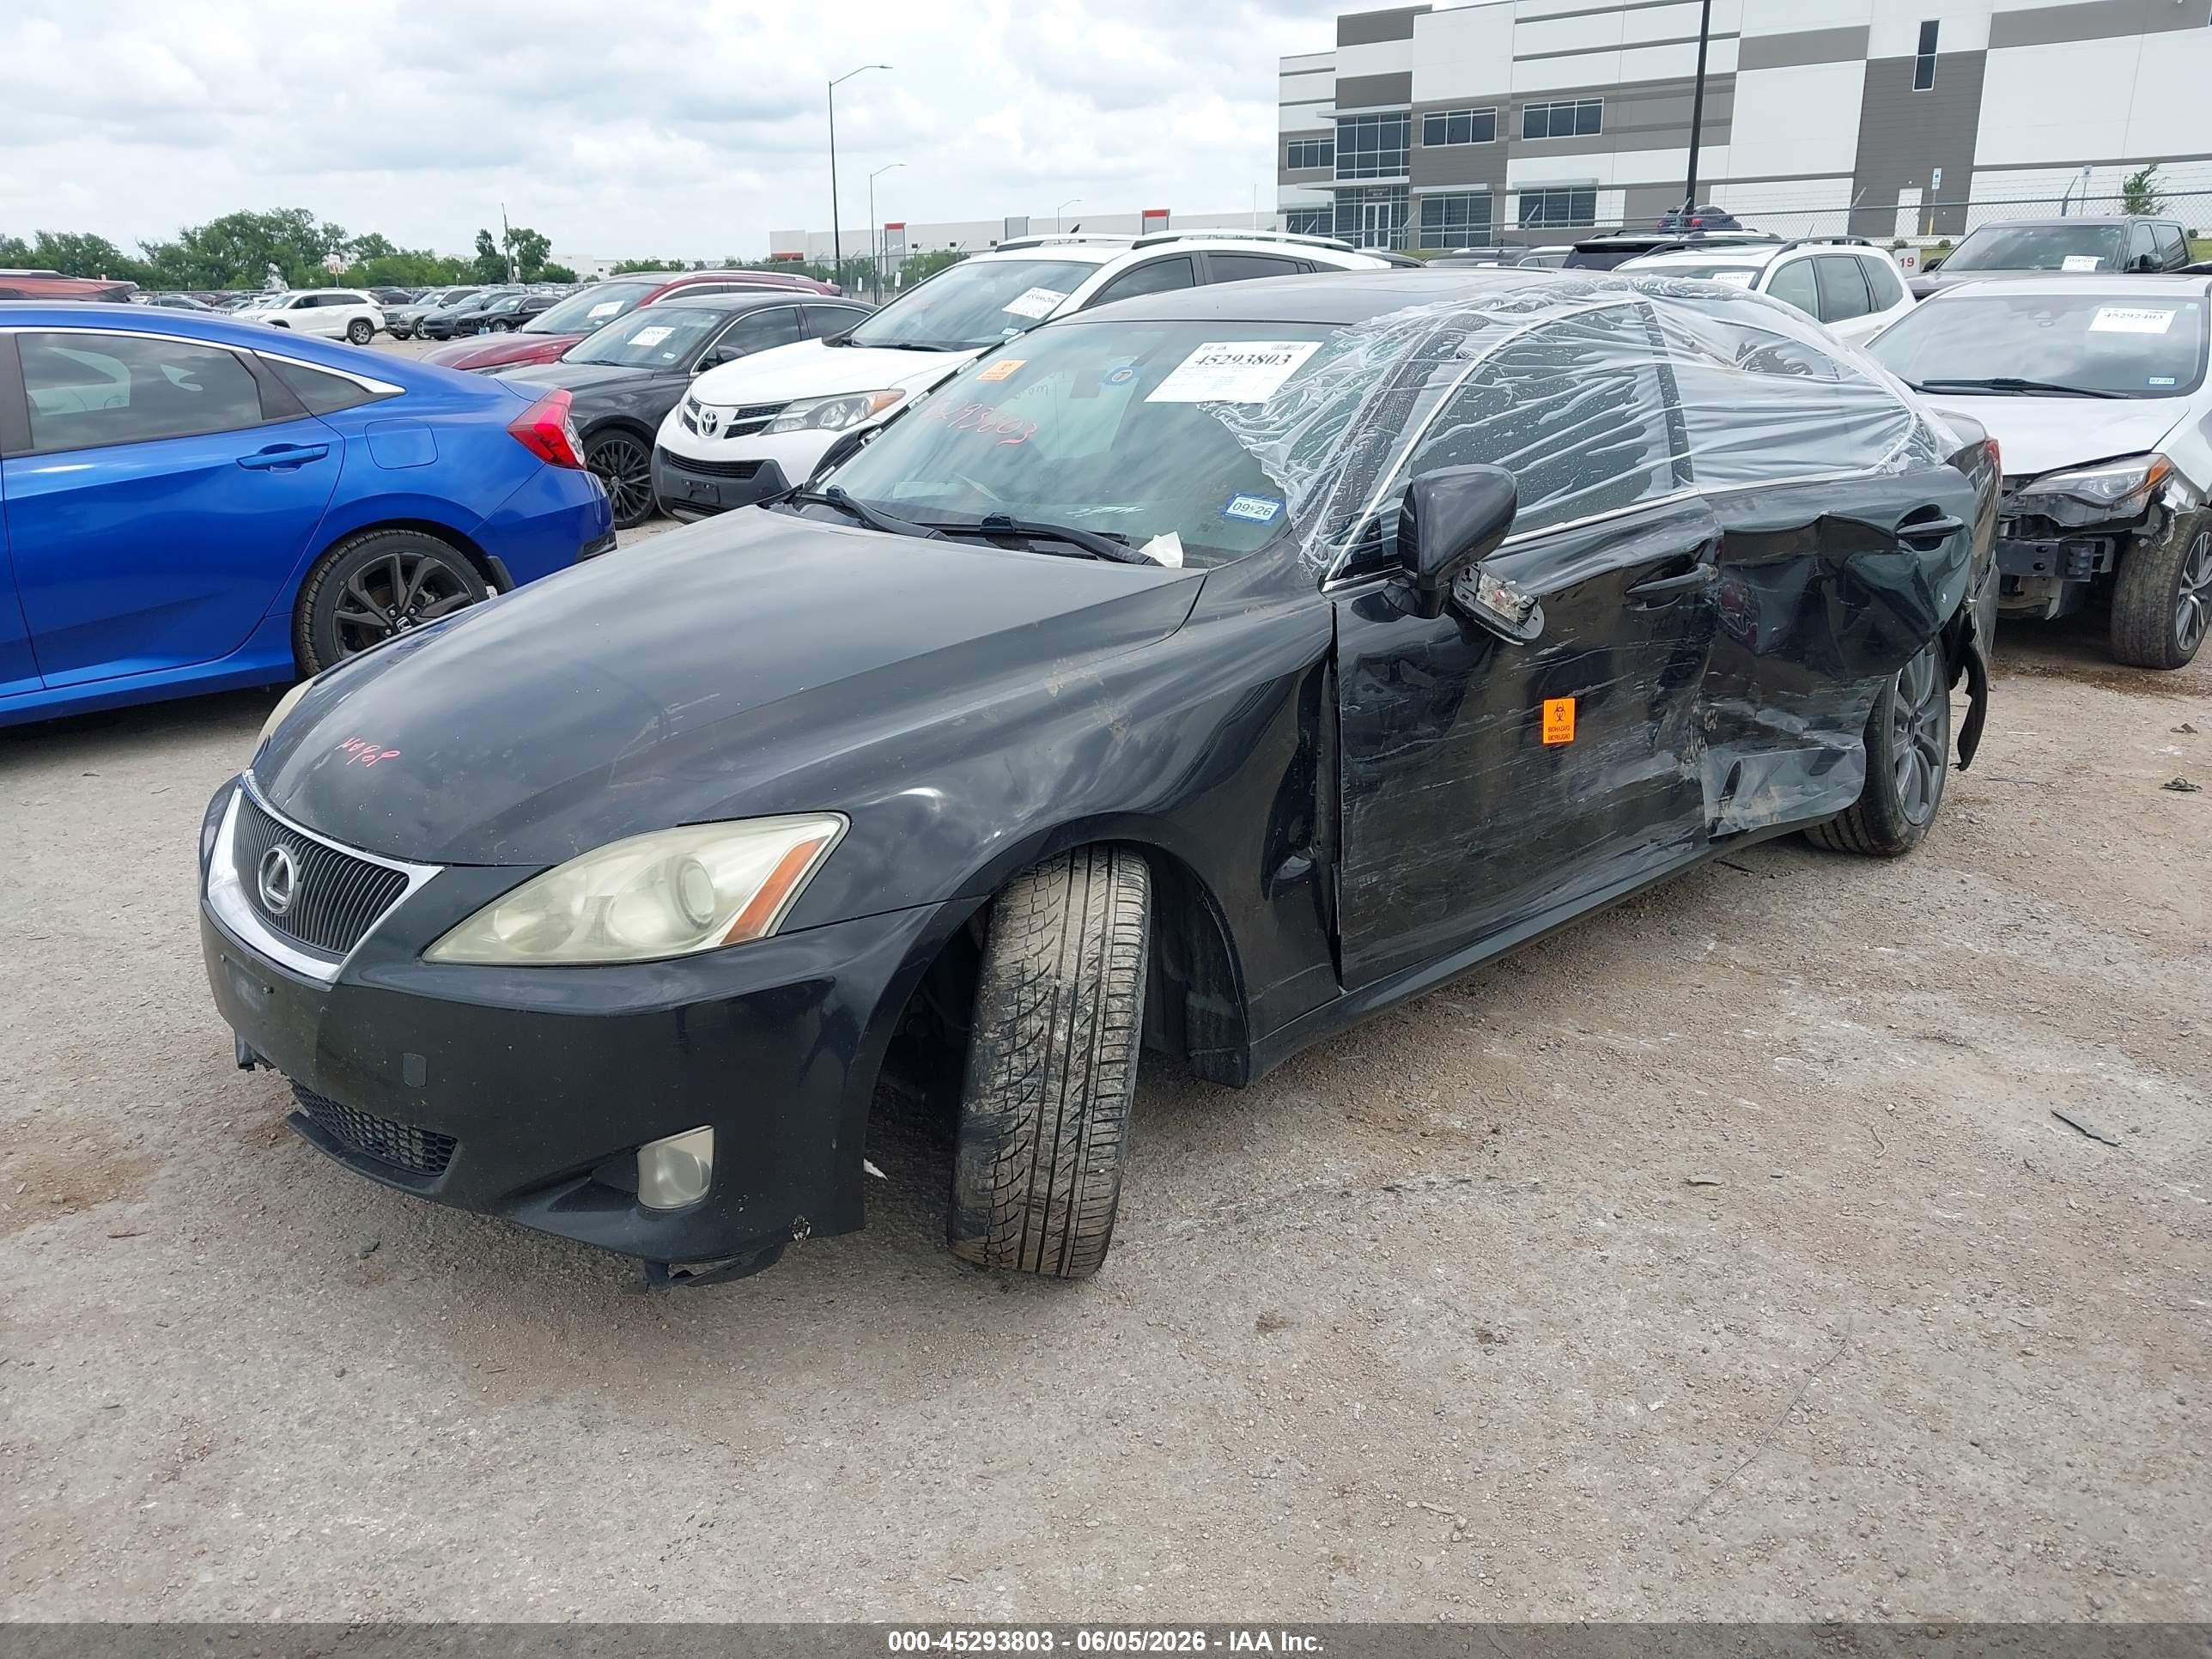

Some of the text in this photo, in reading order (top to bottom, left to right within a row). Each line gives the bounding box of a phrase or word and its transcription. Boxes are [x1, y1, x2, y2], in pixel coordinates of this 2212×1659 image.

[1899, 257, 1915, 268] 19
[1195, 354, 1292, 366] 45293803
[1232, 501, 1273, 516] 09 26
